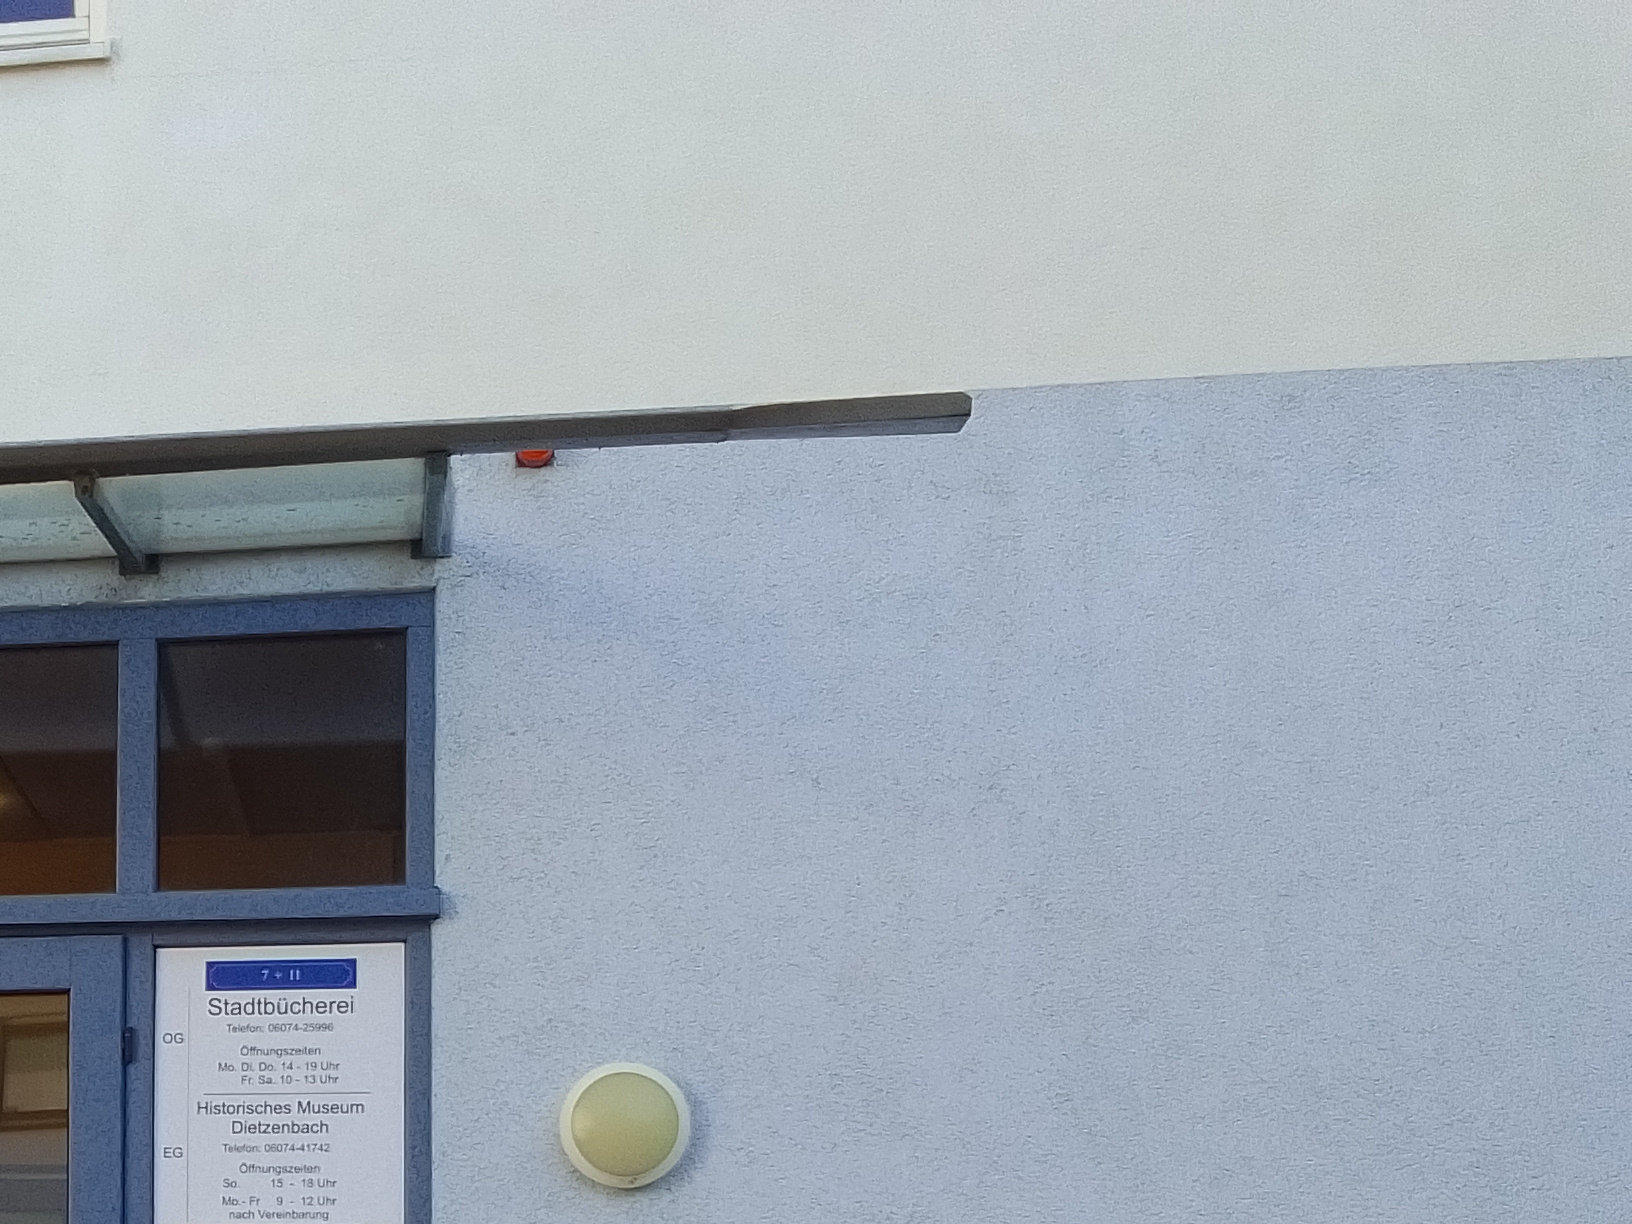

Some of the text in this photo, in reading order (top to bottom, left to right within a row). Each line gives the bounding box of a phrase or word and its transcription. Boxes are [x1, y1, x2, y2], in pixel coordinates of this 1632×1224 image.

[261, 969, 269, 981] 7
[207, 995, 355, 1017] Stadtbücherei
[226, 1023, 265, 1034] Telefon:
[161, 1032, 185, 1045] OG
[239, 1045, 322, 1059] Öffnungszeiten
[217, 1062, 237, 1072] Mo.
[258, 1062, 277, 1072] Do.
[281, 1062, 294, 1071] 14
[304, 1062, 318, 1072] 19
[320, 1061, 341, 1072] Uhr
[280, 1075, 293, 1085] 10
[304, 1075, 317, 1084] 13
[319, 1074, 340, 1085] Uhr
[196, 1100, 366, 1116] Historisches Museum
[230, 1120, 330, 1135] Dietzenbach
[162, 1146, 184, 1159] EG
[222, 1143, 331, 1154] Telefon: 06074-41742
[238, 1162, 321, 1176] Öffnungszeiten
[222, 1178, 241, 1189] So.
[270, 1178, 284, 1188] 15
[317, 1177, 338, 1188] Uhr
[276, 1195, 284, 1206] 9
[301, 1195, 314, 1206] 12
[317, 1195, 338, 1206] Uhr
[228, 1209, 330, 1222] nach Vereinbarung
